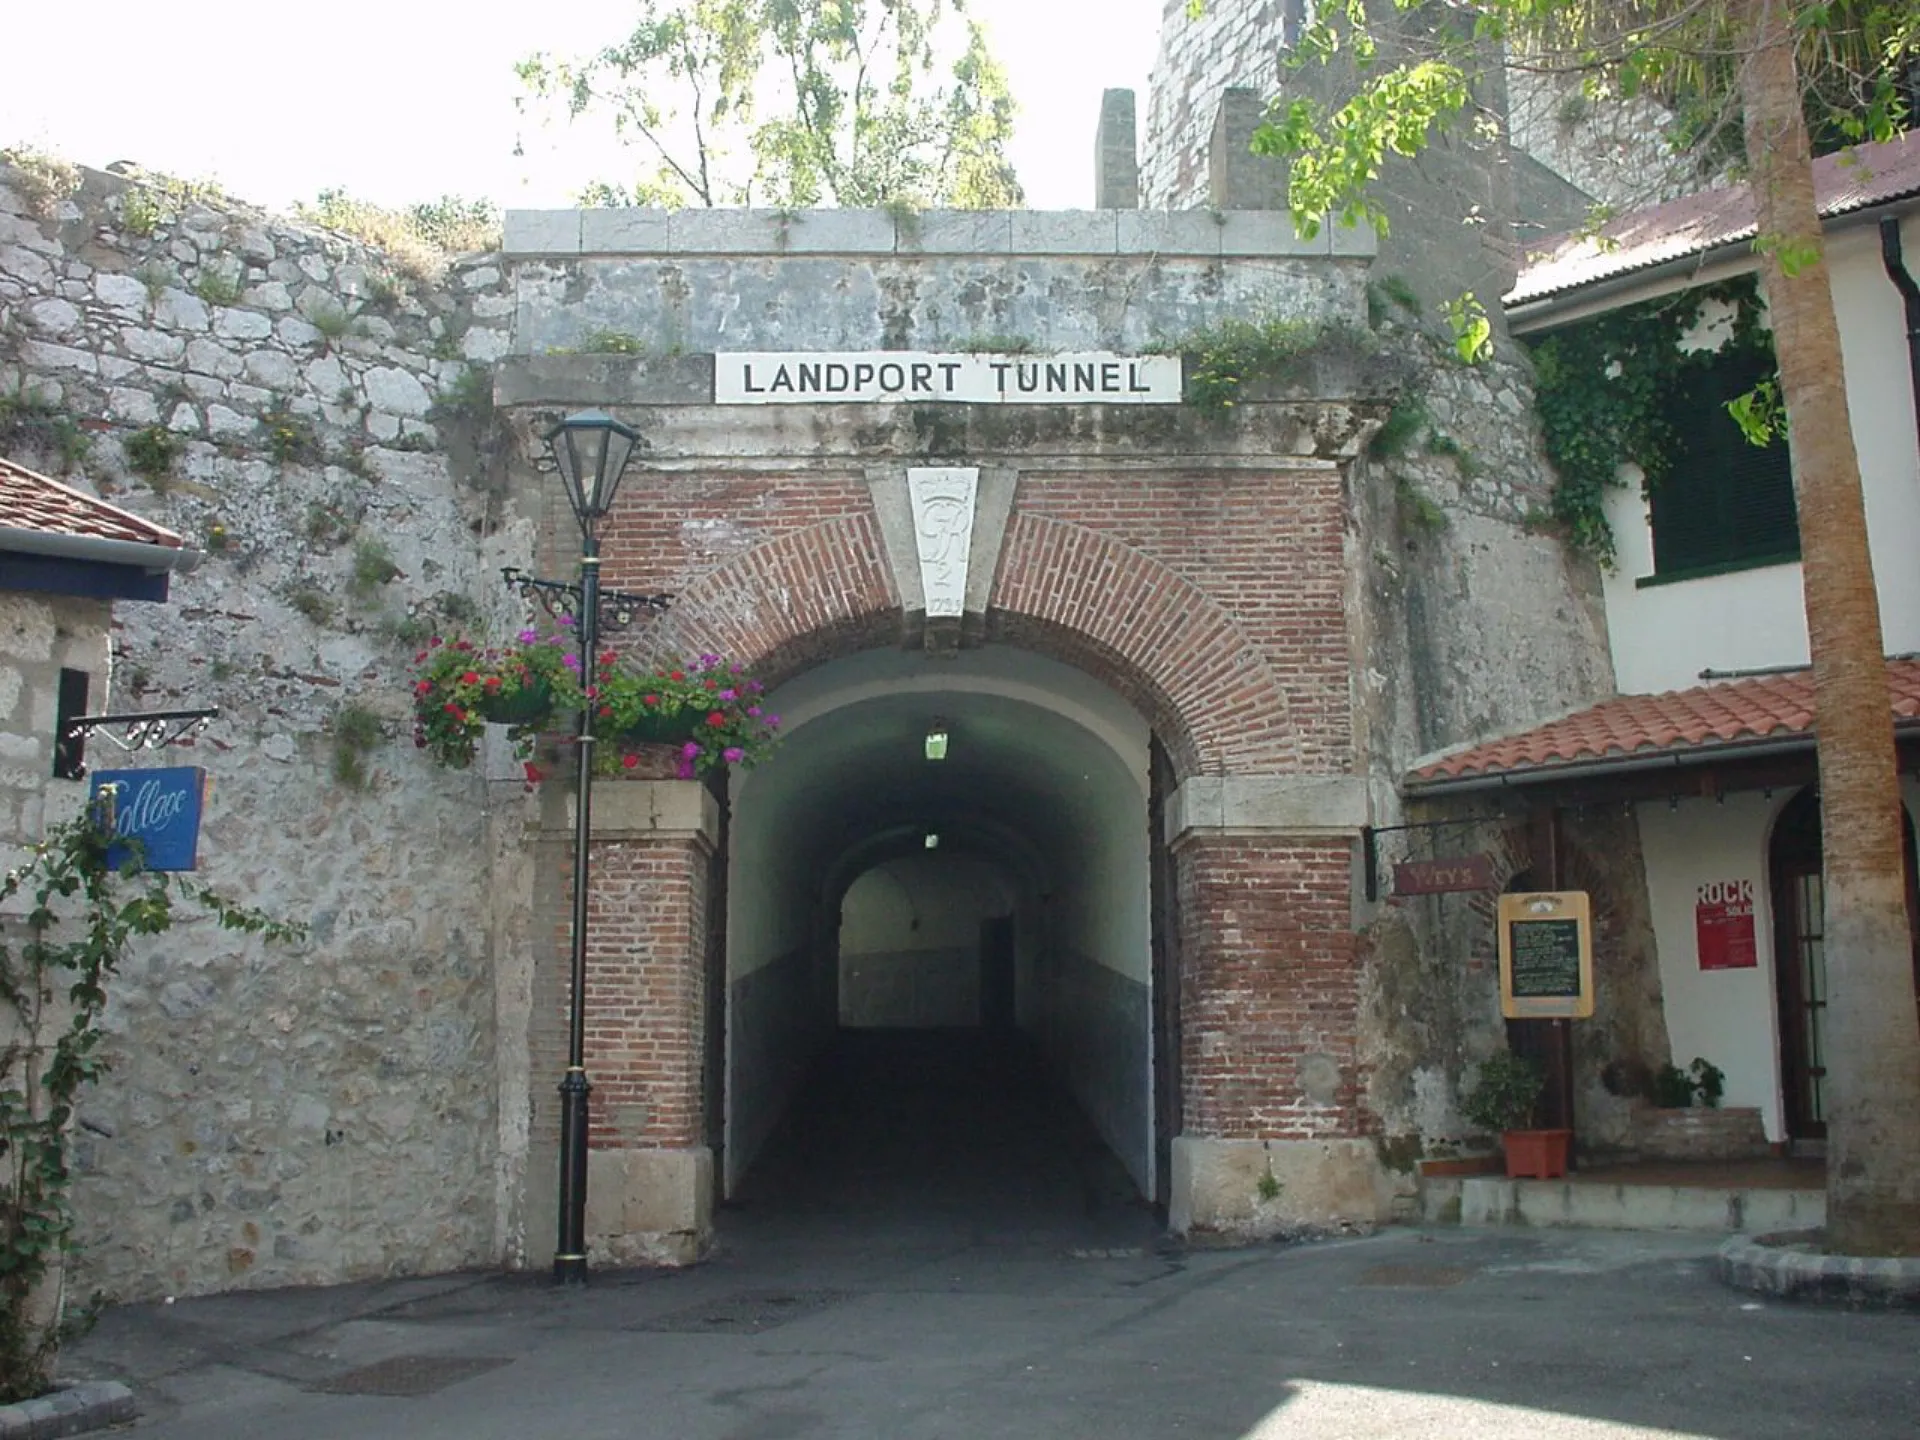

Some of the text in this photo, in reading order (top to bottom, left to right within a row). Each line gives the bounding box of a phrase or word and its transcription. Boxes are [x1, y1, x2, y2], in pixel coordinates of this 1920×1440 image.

[743, 362, 1152, 393] LANDPORT TUNNEL
[1696, 878, 1753, 905] ROCK
